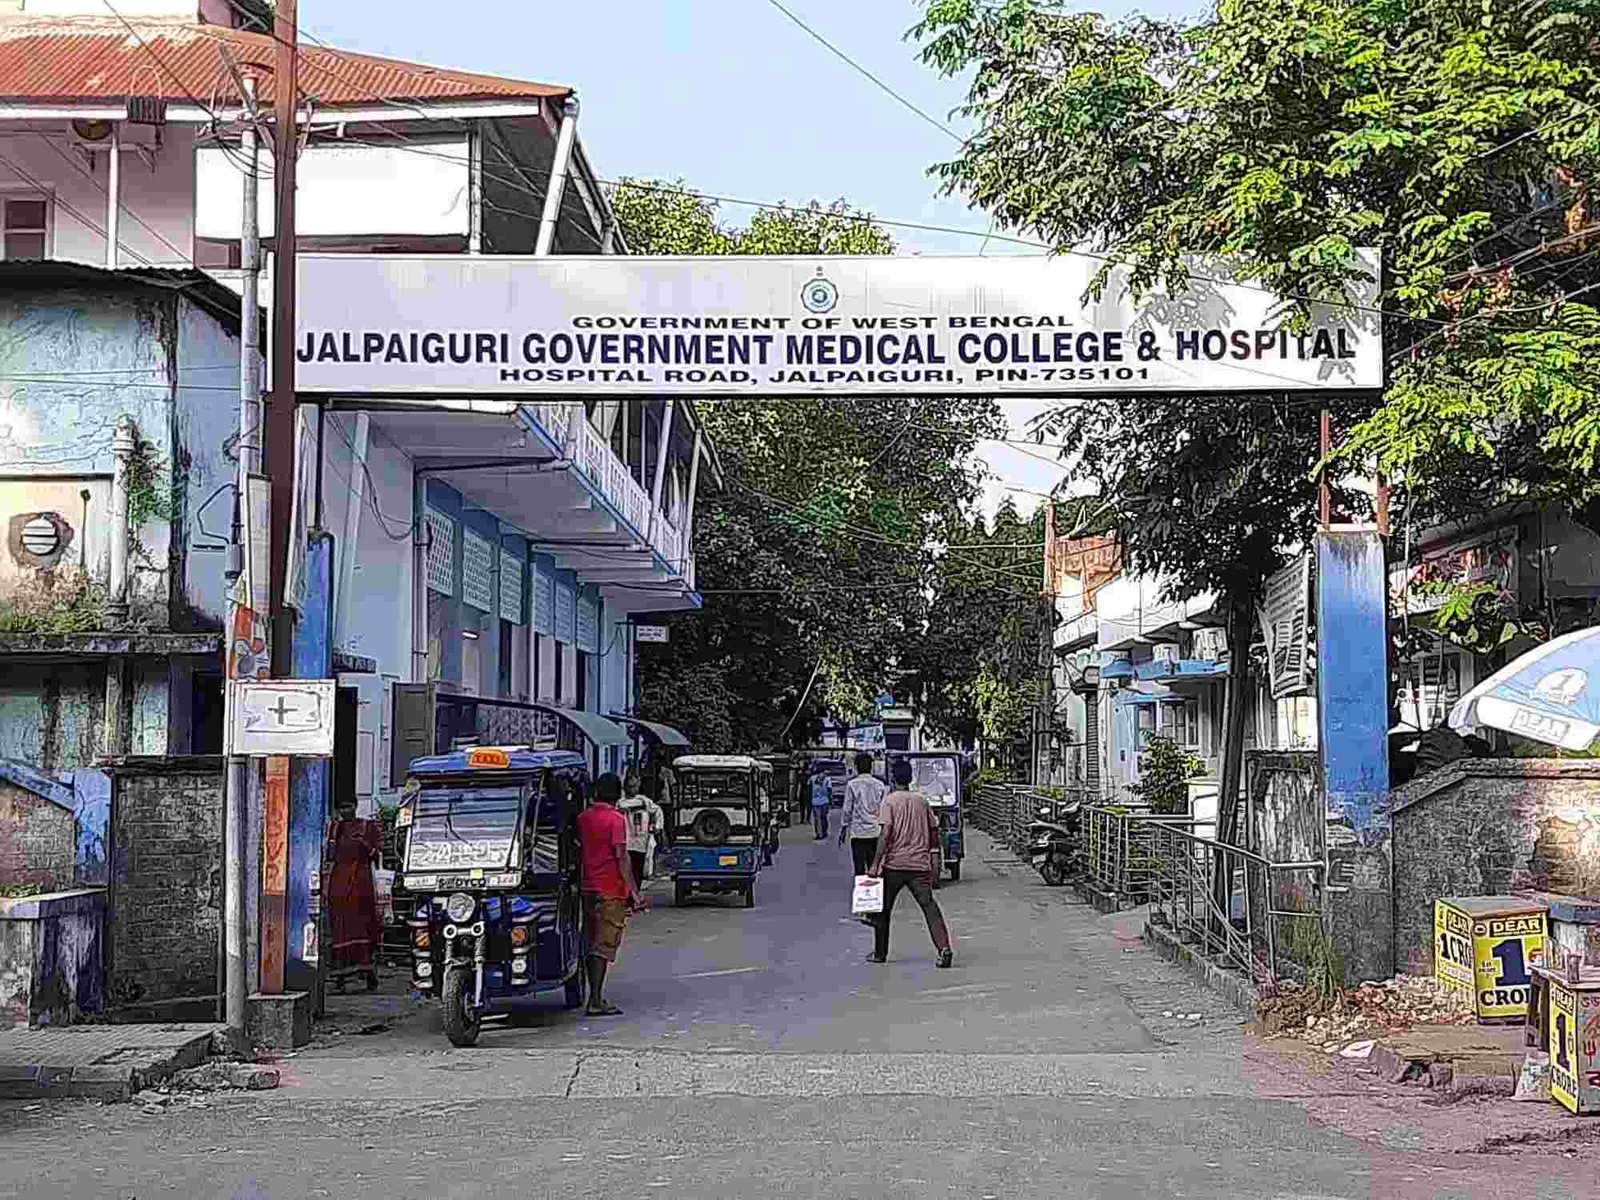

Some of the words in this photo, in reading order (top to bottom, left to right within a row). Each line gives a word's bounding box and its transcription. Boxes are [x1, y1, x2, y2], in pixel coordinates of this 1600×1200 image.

[573, 317, 790, 329] GOVERNMENT
[802, 317, 840, 329] OF
[852, 317, 937, 329] WEST
[949, 316, 1072, 328] BENGAL
[297, 333, 508, 363] JALPAIGURI
[523, 333, 773, 364] GOVERNMENT
[787, 334, 945, 364] MEDICAL
[959, 331, 1123, 363] COLLEGE
[1138, 331, 1161, 361] &
[1176, 328, 1356, 361] HOSPITAL
[501, 369, 652, 382] HOSPITAL
[665, 370, 757, 384] ROAD,
[770, 370, 962, 384] JALPAIGURI,
[976, 368, 1147, 381] PIN-735101
[1493, 919, 1541, 932] DEAR
[1492, 938, 1532, 986] 1
[1480, 988, 1530, 1007] CRO
